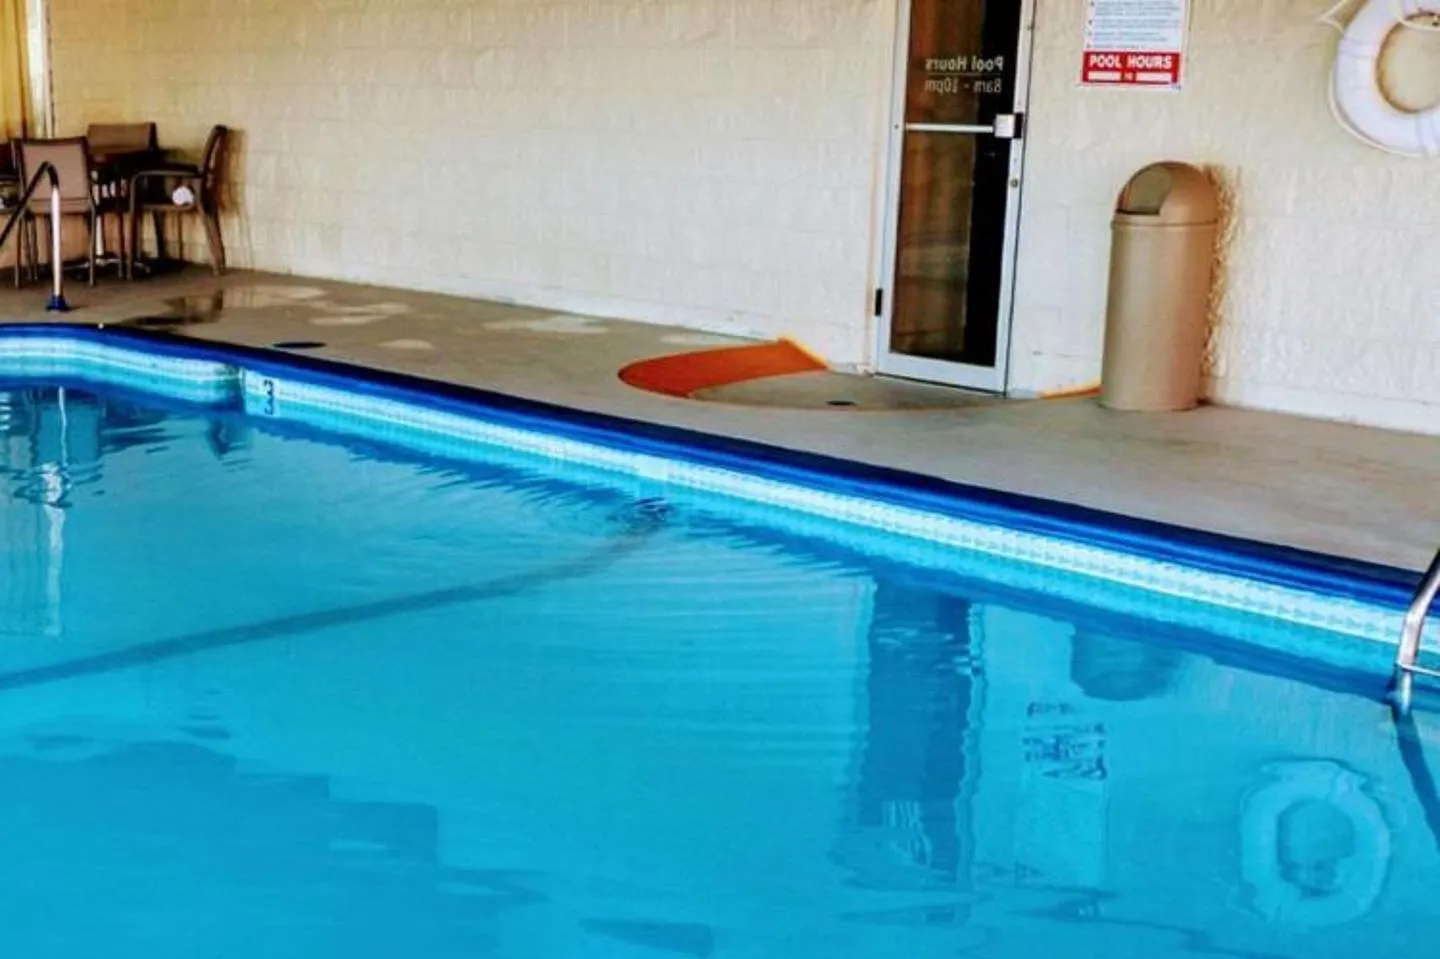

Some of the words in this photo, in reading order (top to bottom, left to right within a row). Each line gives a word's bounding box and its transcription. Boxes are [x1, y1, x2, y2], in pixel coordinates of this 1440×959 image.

[1089, 54, 1122, 69] POOL
[1126, 55, 1172, 69] HOURS
[263, 379, 274, 416] 3
